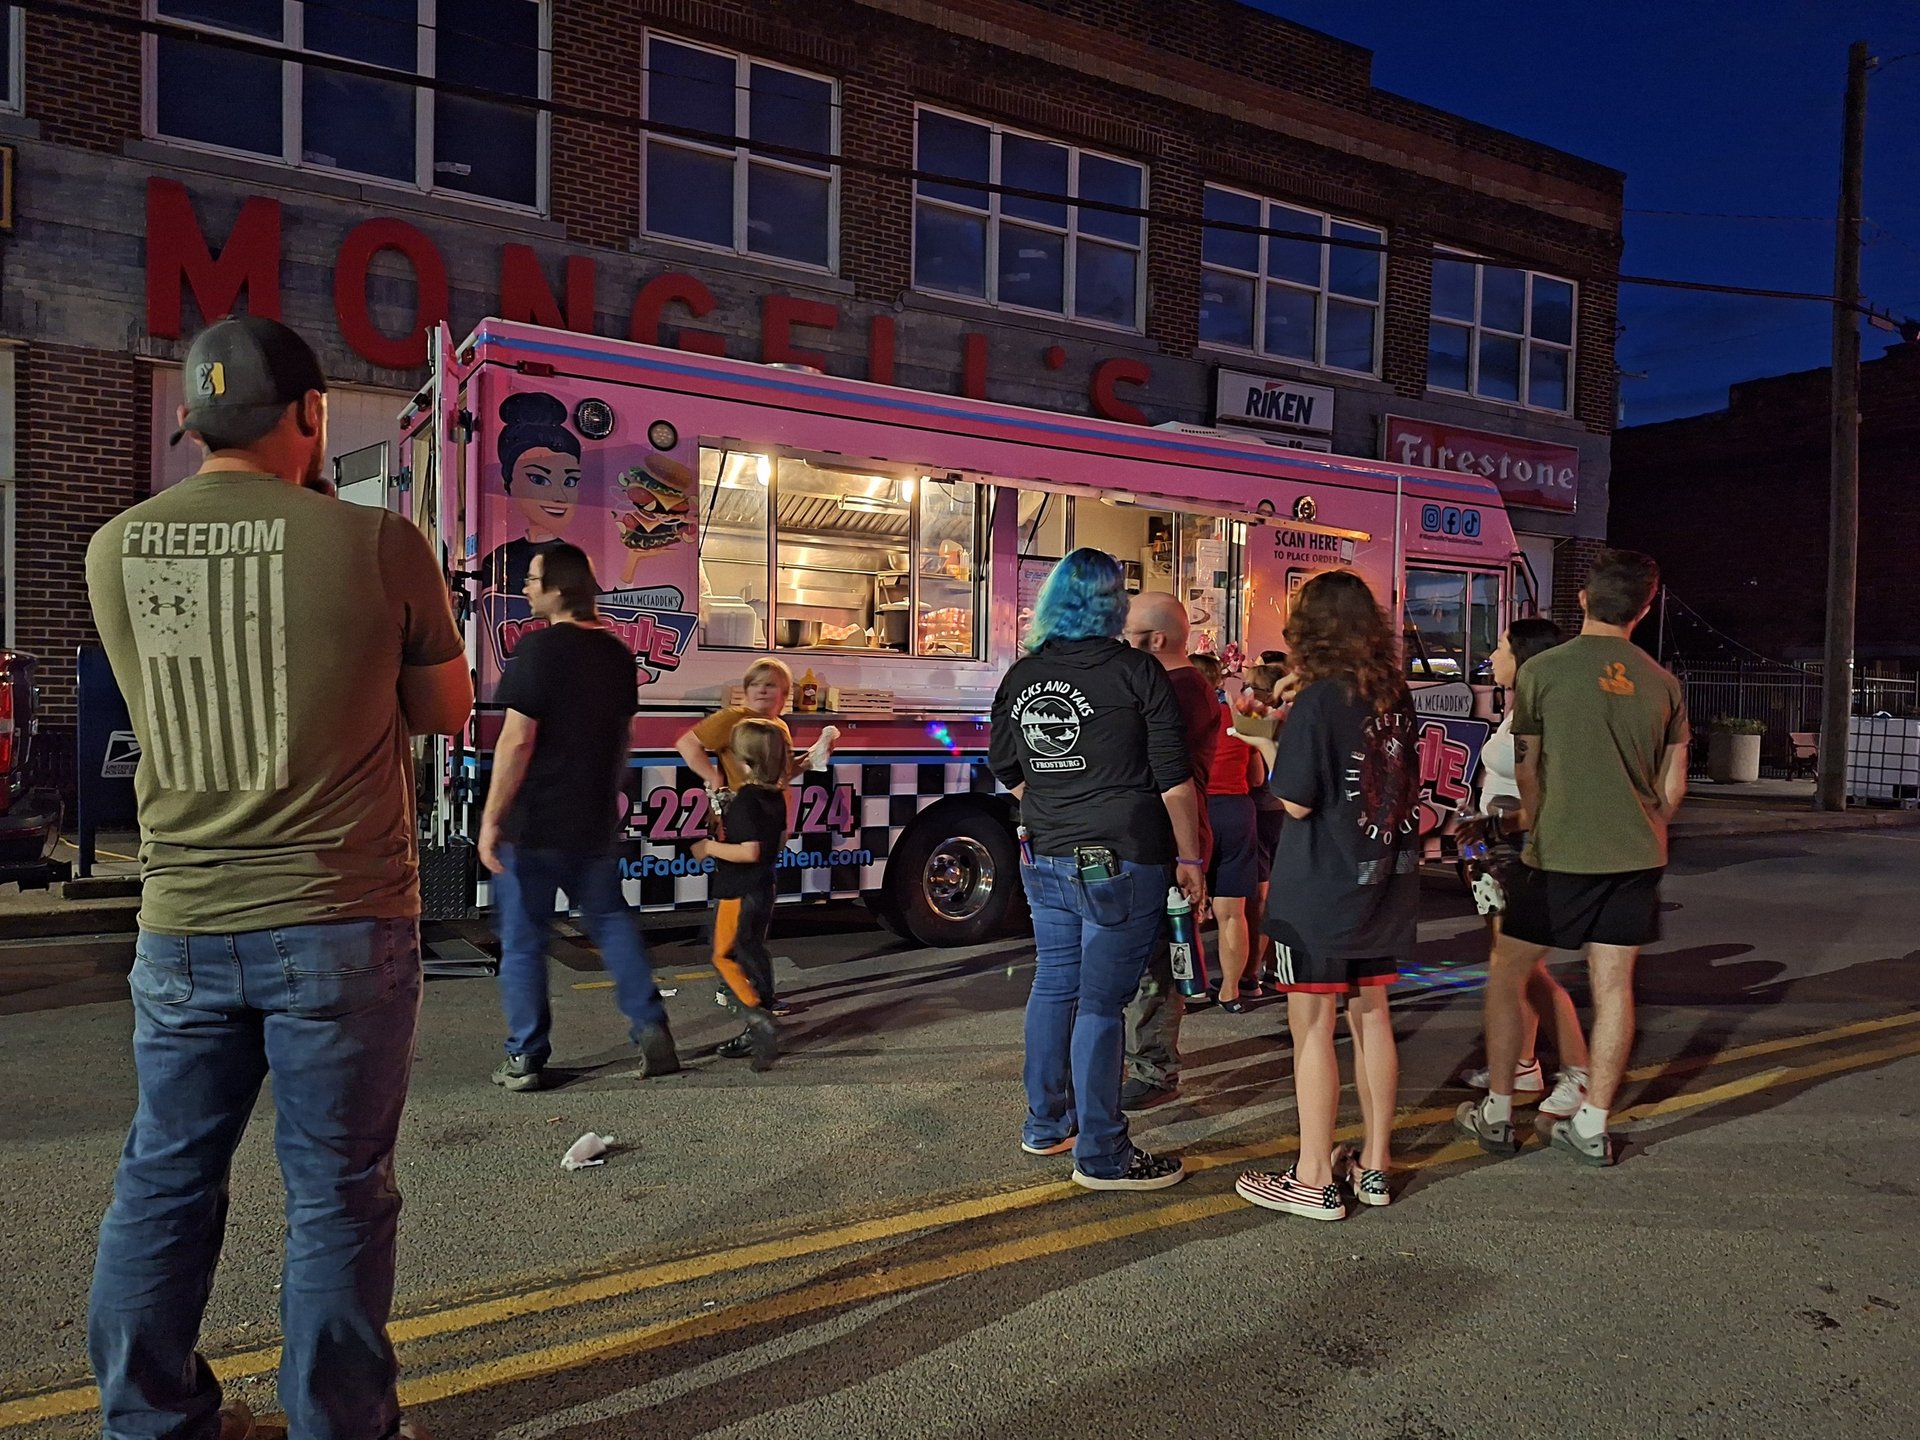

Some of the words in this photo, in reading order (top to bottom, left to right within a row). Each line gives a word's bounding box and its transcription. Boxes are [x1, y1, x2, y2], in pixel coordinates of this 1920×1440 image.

[1396, 432, 1575, 489] Firestone
[121, 518, 286, 556] FREEDOM
[1275, 530, 1306, 549] SCAN
[1309, 533, 1339, 552] HERE
[1273, 550, 1285, 560] TO
[1286, 551, 1310, 562] PLACE
[1312, 553, 1338, 564] ORDER
[612, 594, 635, 605] MAMA
[636, 594, 679, 608] MCFADDEN'S
[1010, 682, 1042, 721] TRACKS
[1043, 680, 1071, 694] AND
[1068, 688, 1095, 717] YAKS
[1425, 694, 1470, 713] MCFADDEN'S
[1035, 759, 1080, 769] FROSTBURG
